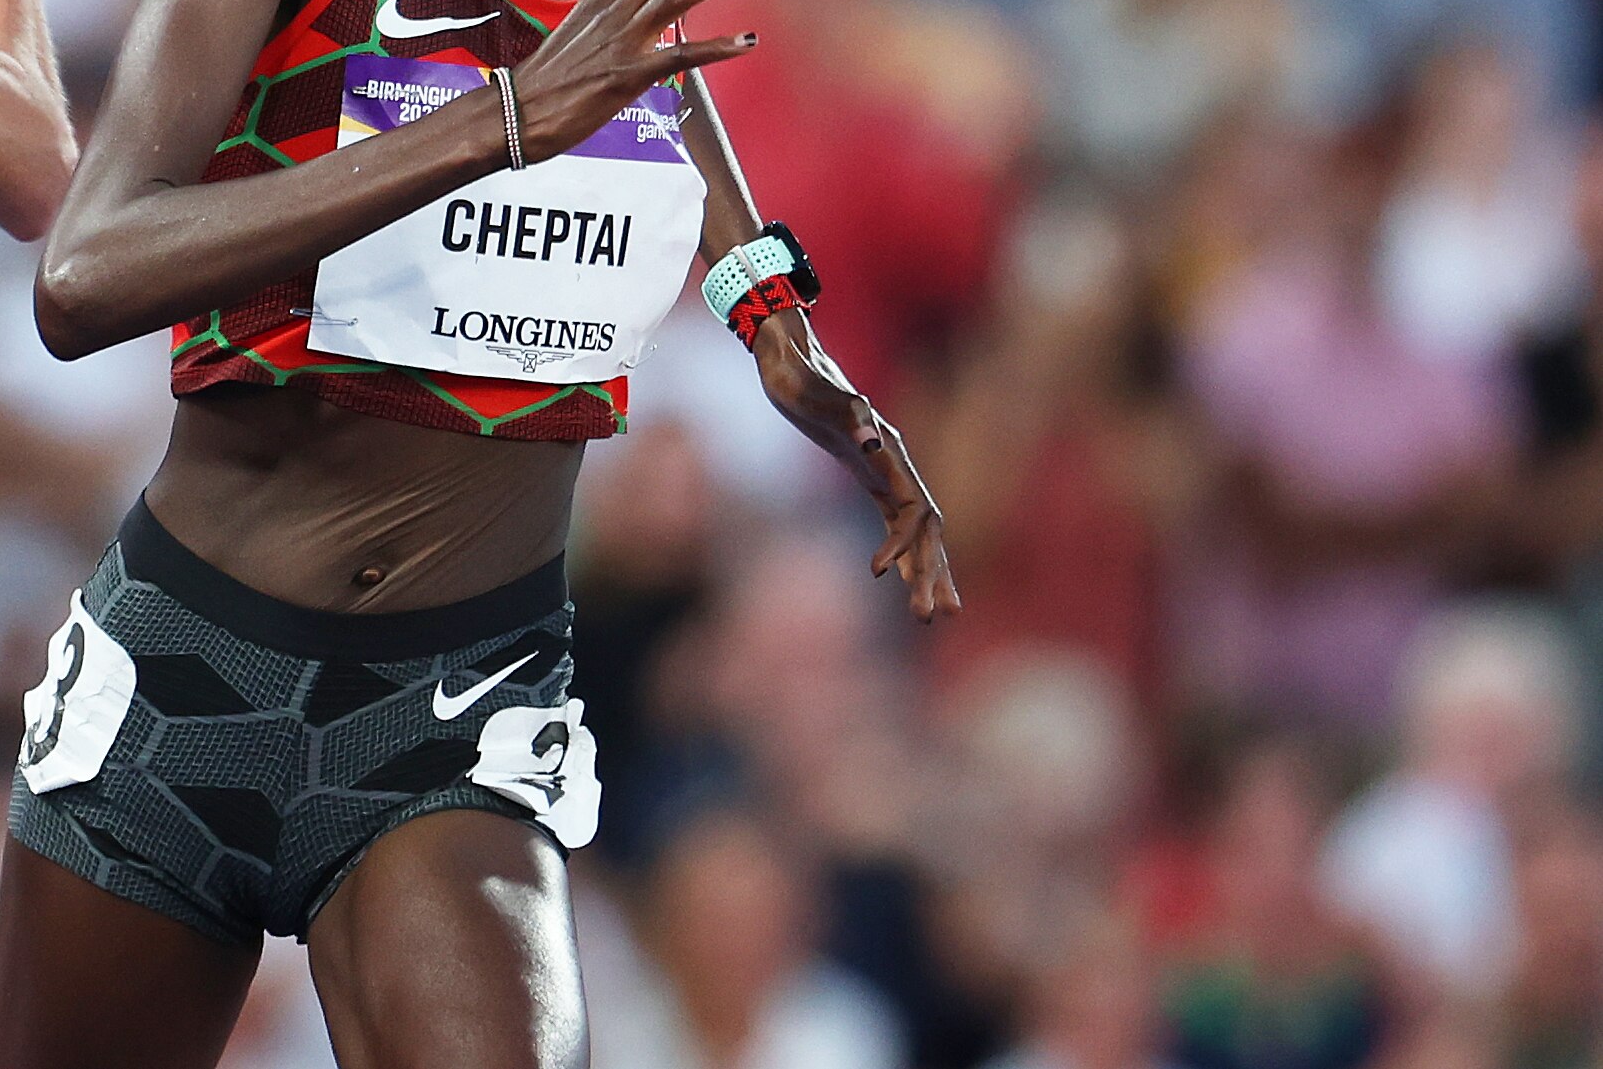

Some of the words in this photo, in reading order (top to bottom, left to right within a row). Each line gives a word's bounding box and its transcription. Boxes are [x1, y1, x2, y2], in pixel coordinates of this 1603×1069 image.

[367, 79, 468, 108] BIRMINGHA
[441, 198, 633, 267] CHEPTAI
[430, 306, 617, 352] LONGINES
